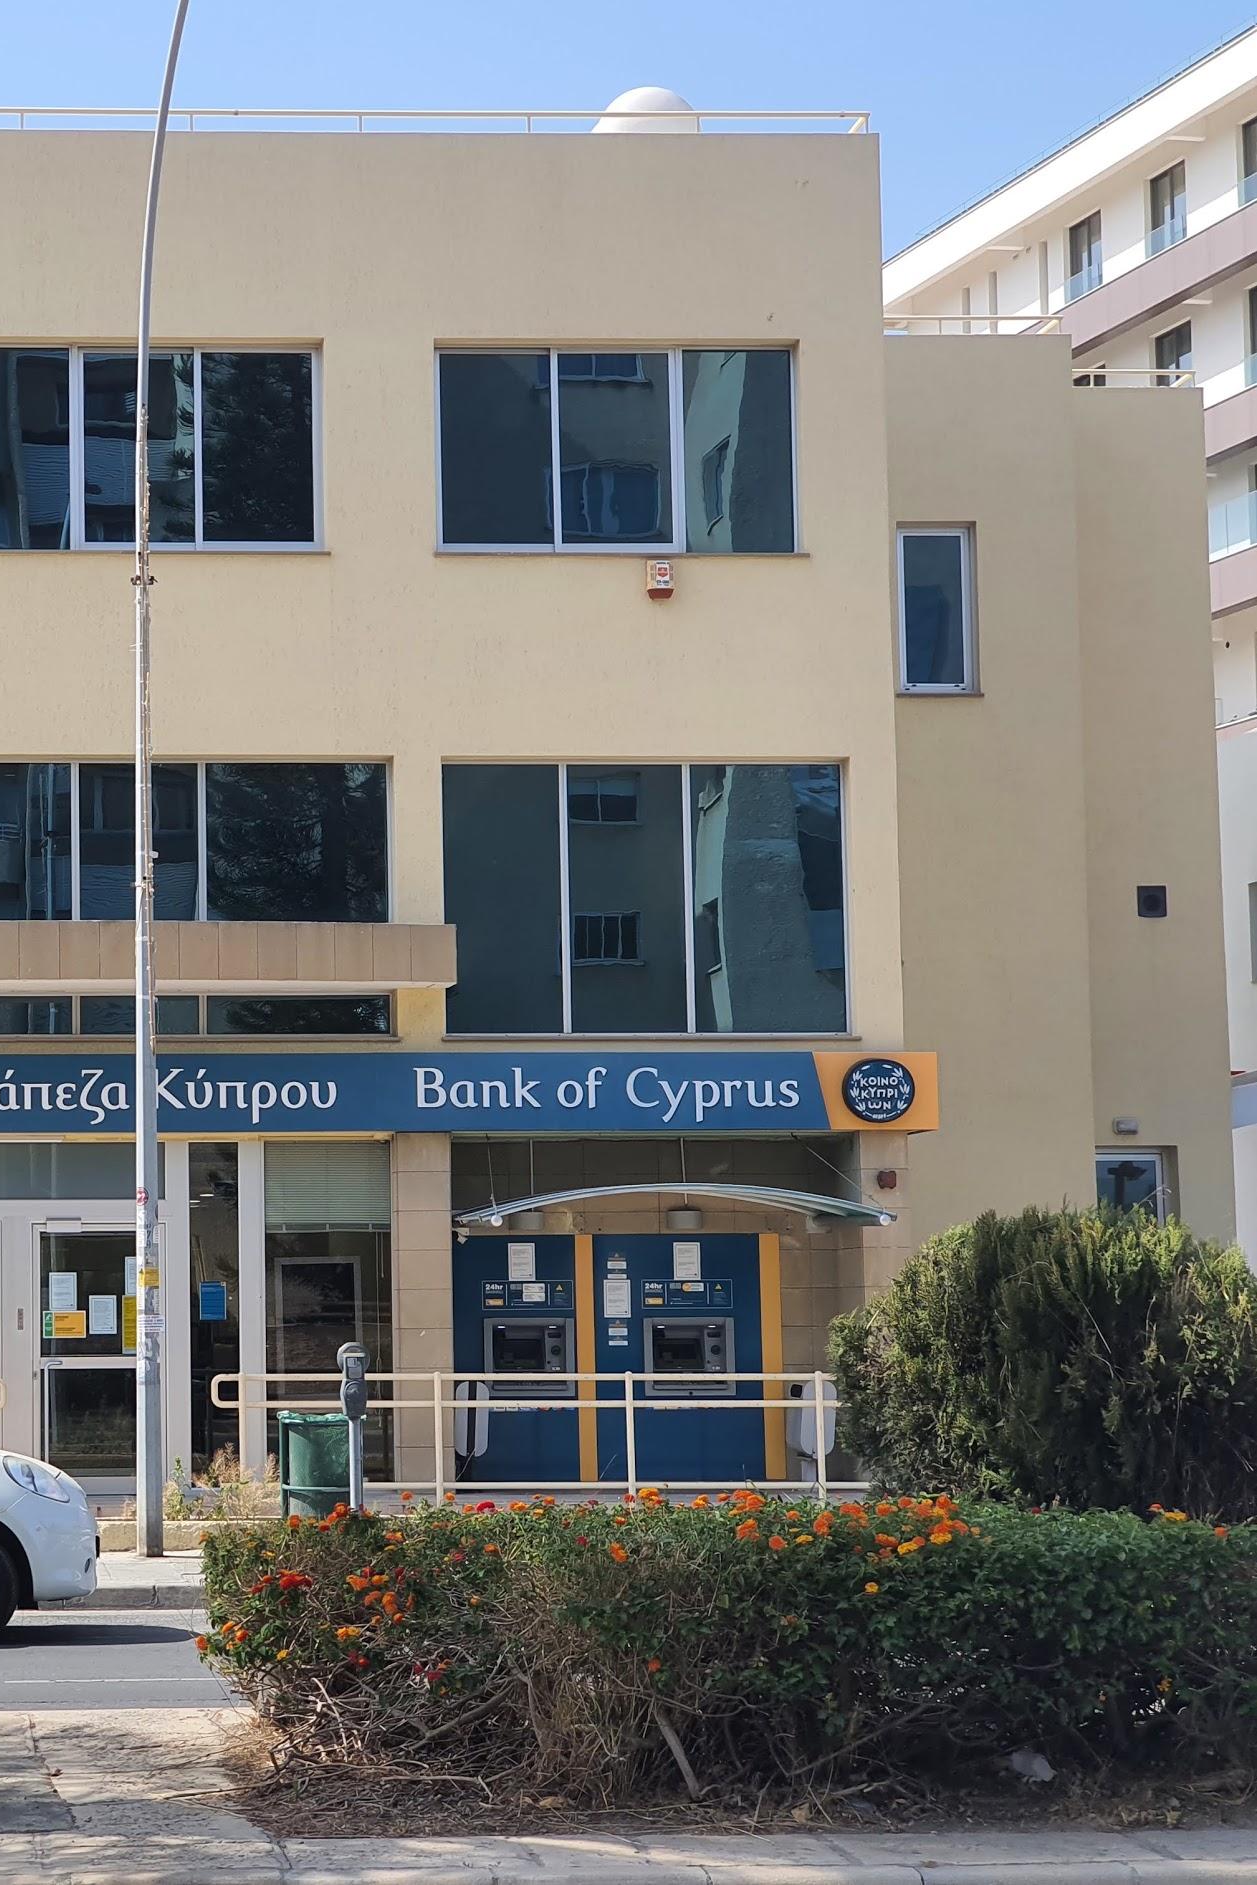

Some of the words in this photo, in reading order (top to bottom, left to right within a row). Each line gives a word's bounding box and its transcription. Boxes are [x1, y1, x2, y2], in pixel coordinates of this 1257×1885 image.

[156, 1067, 338, 1126] Κύπρου
[413, 1066, 542, 1109] Bank
[556, 1066, 607, 1109] of
[626, 1066, 800, 1123] Cyprus
[860, 1076, 898, 1087] ΚΟΙΝΟ
[861, 1087, 898, 1099] ΚΥΠΡΙ
